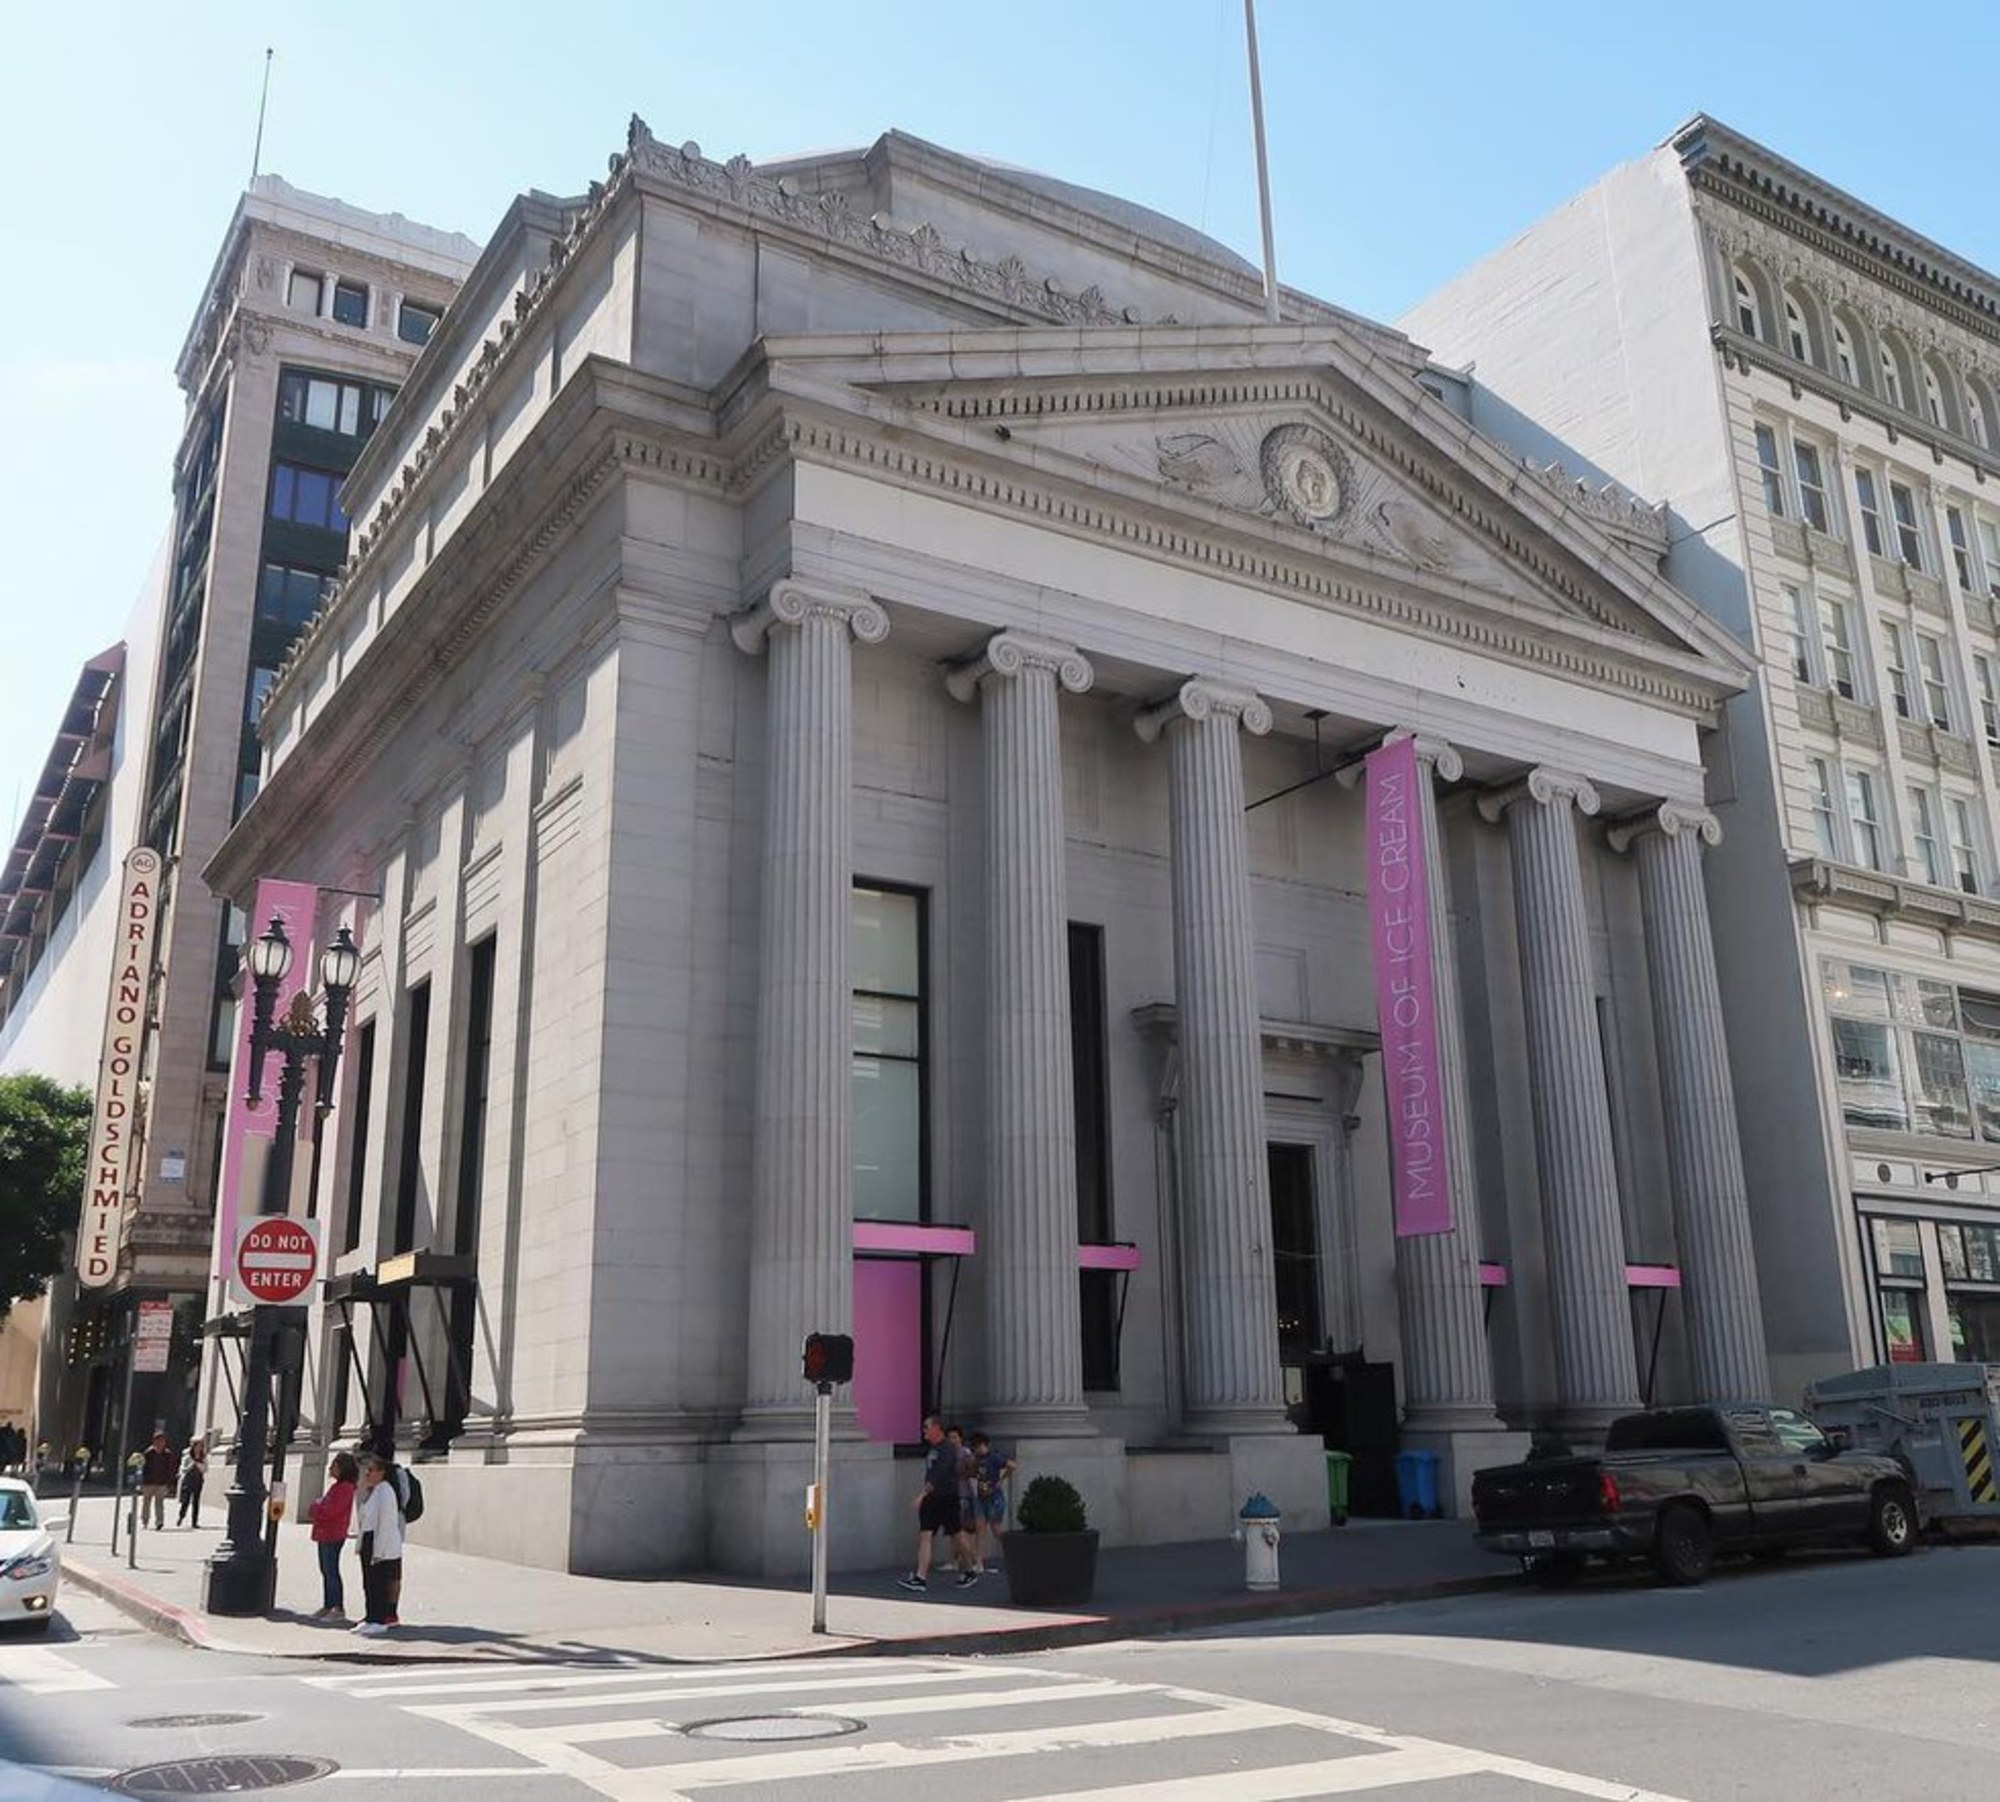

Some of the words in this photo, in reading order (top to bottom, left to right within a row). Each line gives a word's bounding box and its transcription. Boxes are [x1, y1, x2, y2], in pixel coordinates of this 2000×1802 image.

[1379, 772, 1410, 893] CREAM
[116, 881, 150, 1024] ADRIANO
[1385, 904, 1415, 963] ICE
[1391, 976, 1421, 1028] OF
[88, 1036, 132, 1277] GOLDSCHMIED
[1398, 1041, 1436, 1199] MUSEUM
[250, 1234, 272, 1248] DO
[278, 1235, 309, 1250] NOT
[250, 1272, 302, 1287] ENTER
